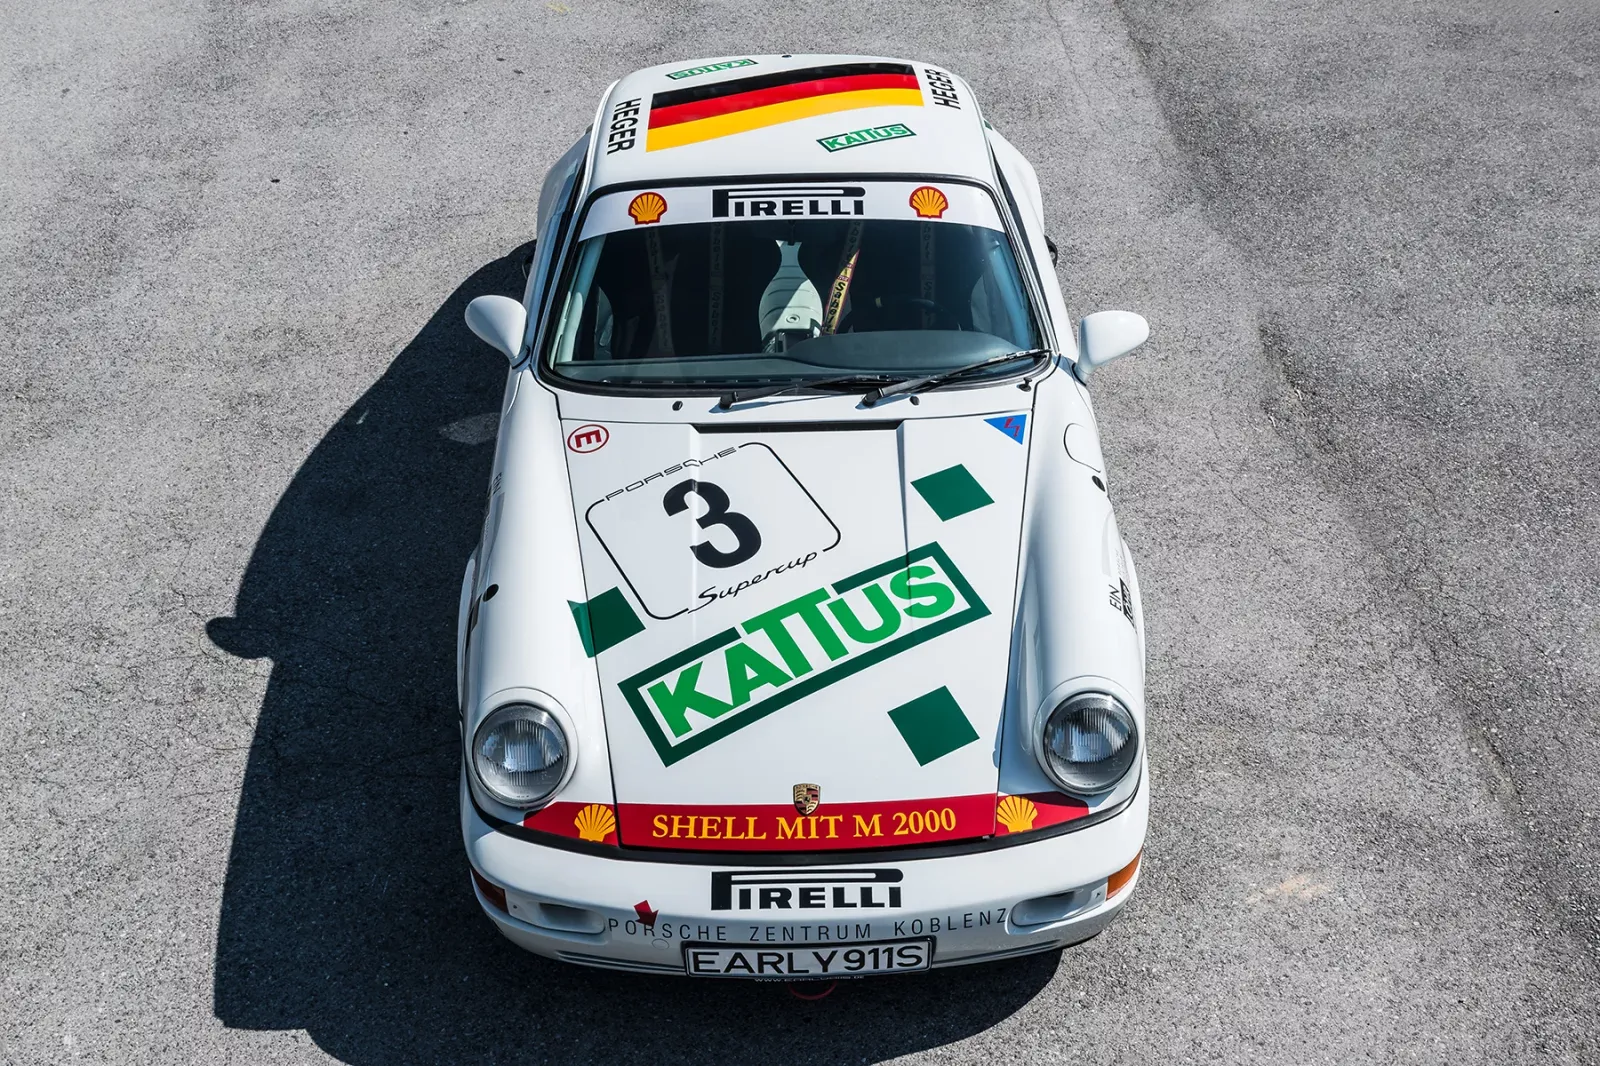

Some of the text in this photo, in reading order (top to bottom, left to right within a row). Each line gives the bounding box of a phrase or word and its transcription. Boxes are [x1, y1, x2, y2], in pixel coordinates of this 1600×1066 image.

[924, 69, 961, 110] HEGER
[607, 98, 641, 155] HEGER
[824, 126, 908, 149] KATTUS
[712, 187, 865, 217] PIRELLI
[605, 447, 738, 502] PORSCHE
[663, 478, 762, 569] 3
[687, 551, 818, 614] Supercup
[647, 565, 956, 739] KATTUS
[652, 807, 957, 840] SHELL MIT M 2000
[711, 869, 903, 911] PIRELLI
[608, 907, 1007, 942] PORSCHE ZENTRUM KOBLENZ
[691, 945, 923, 975] EARLY911S
